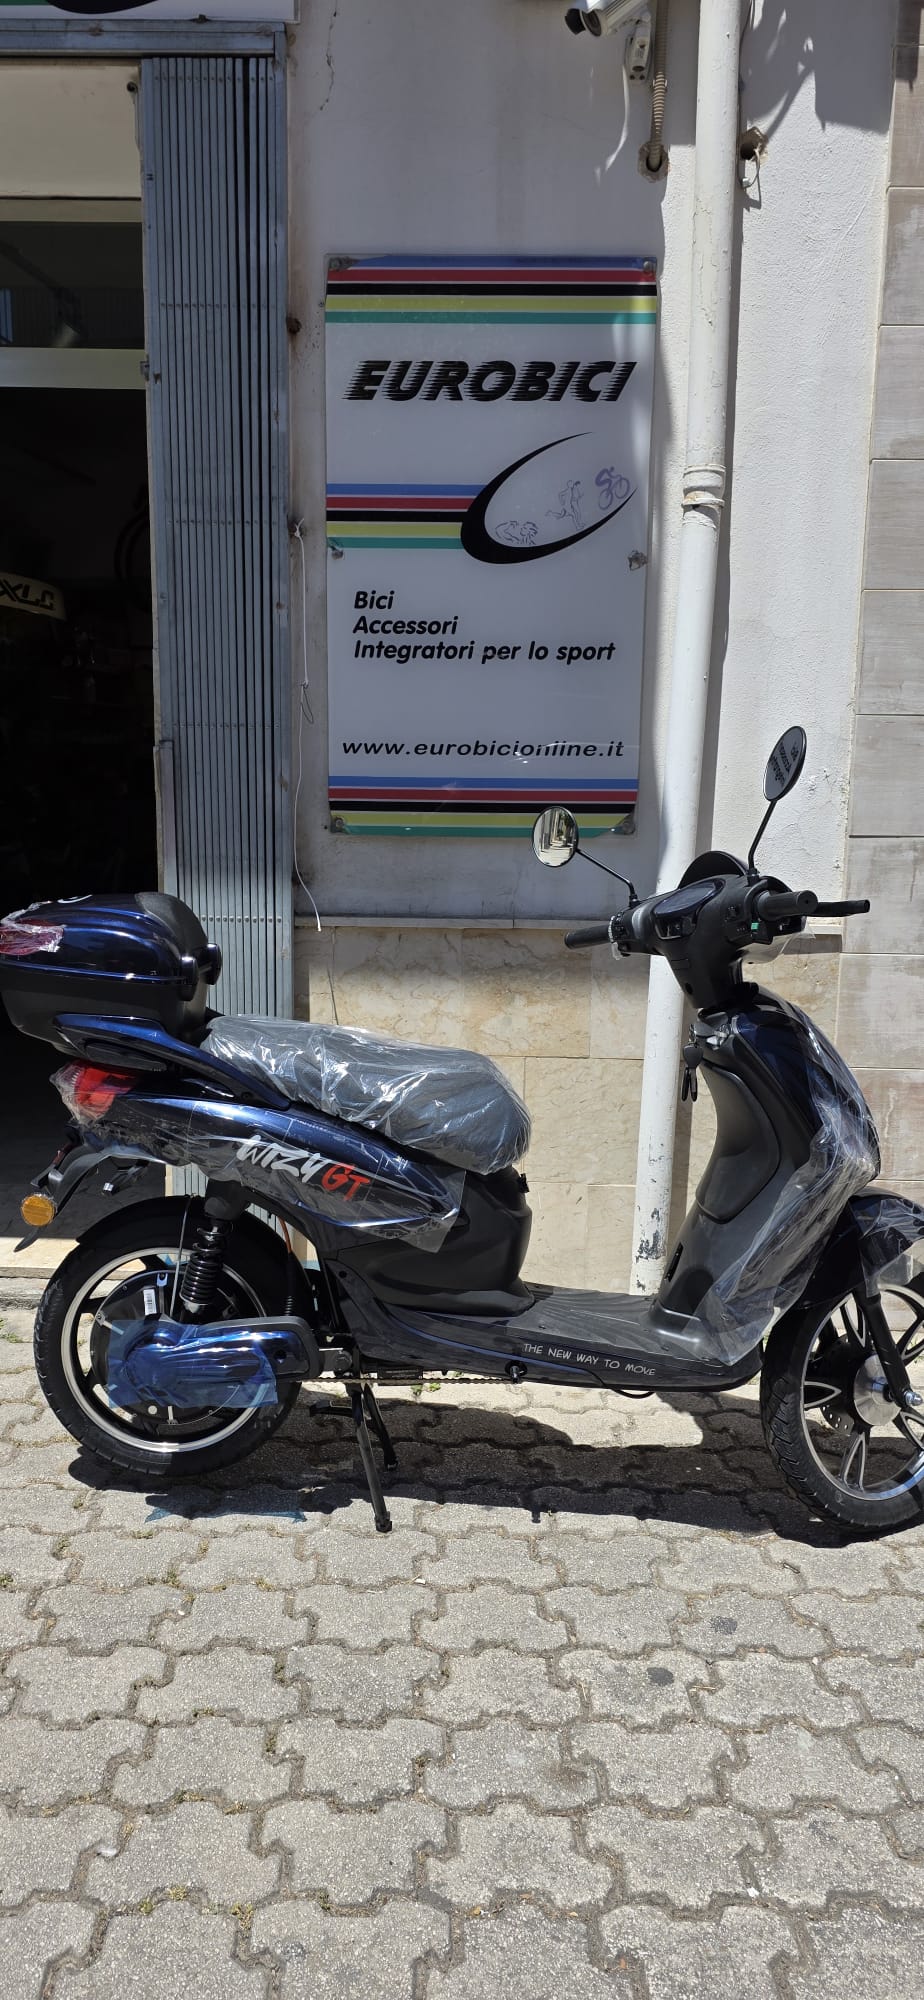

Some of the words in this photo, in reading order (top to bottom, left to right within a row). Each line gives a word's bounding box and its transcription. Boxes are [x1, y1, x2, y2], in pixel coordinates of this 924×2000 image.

[342, 360, 637, 402] EUROBICI
[353, 590, 395, 610] Bici
[352, 616, 459, 635] Accessori
[353, 640, 475, 664] Integratori
[481, 648, 521, 665] per
[528, 641, 549, 661] lo
[556, 642, 616, 665] sport
[321, 1164, 370, 1200] GT
[523, 1343, 544, 1354] THE
[548, 1347, 572, 1360] NEW
[576, 1354, 599, 1365] WAY
[604, 1359, 620, 1369] TO
[624, 1363, 656, 1377] MOVE
